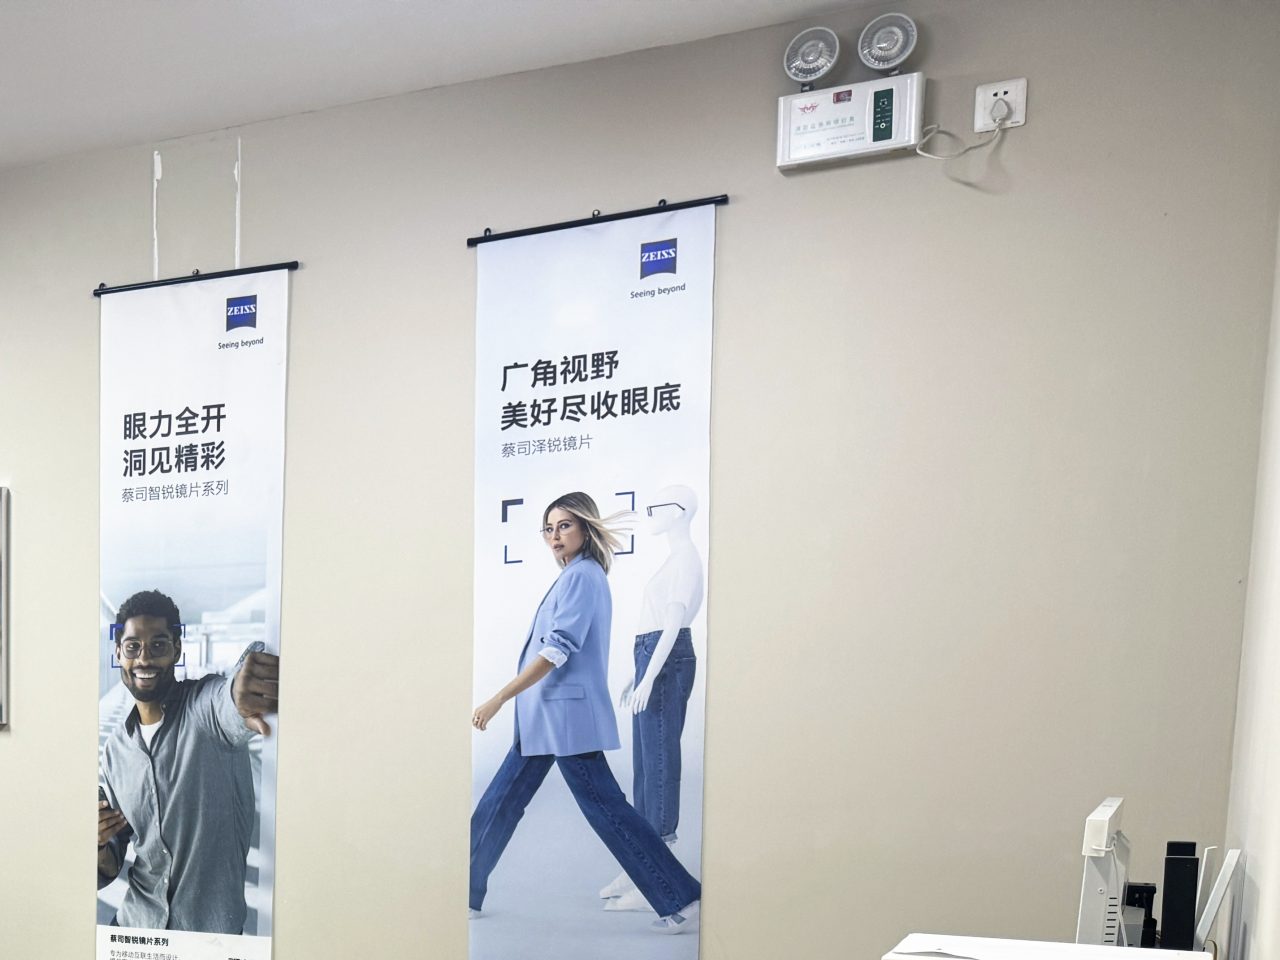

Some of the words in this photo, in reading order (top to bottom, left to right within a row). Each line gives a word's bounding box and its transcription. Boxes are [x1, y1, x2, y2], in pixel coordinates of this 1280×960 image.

[641, 248, 676, 262] ZEISS
[630, 288, 655, 299] Seeing
[658, 283, 686, 296] beyond
[227, 304, 256, 316] ZEISS
[218, 339, 239, 350] Seeing
[241, 337, 264, 348] beyond
[501, 350, 619, 392] 广角视野
[500, 382, 682, 431] 美好尽收眼底
[123, 403, 227, 440] 眼力全开
[501, 433, 593, 458] 蔡司泽锐镜片
[122, 440, 226, 477] 洞见精彩
[121, 479, 229, 503] 蔡司智锐镜片系列
[110, 934, 169, 947] 蔡司智锐镜片系列
